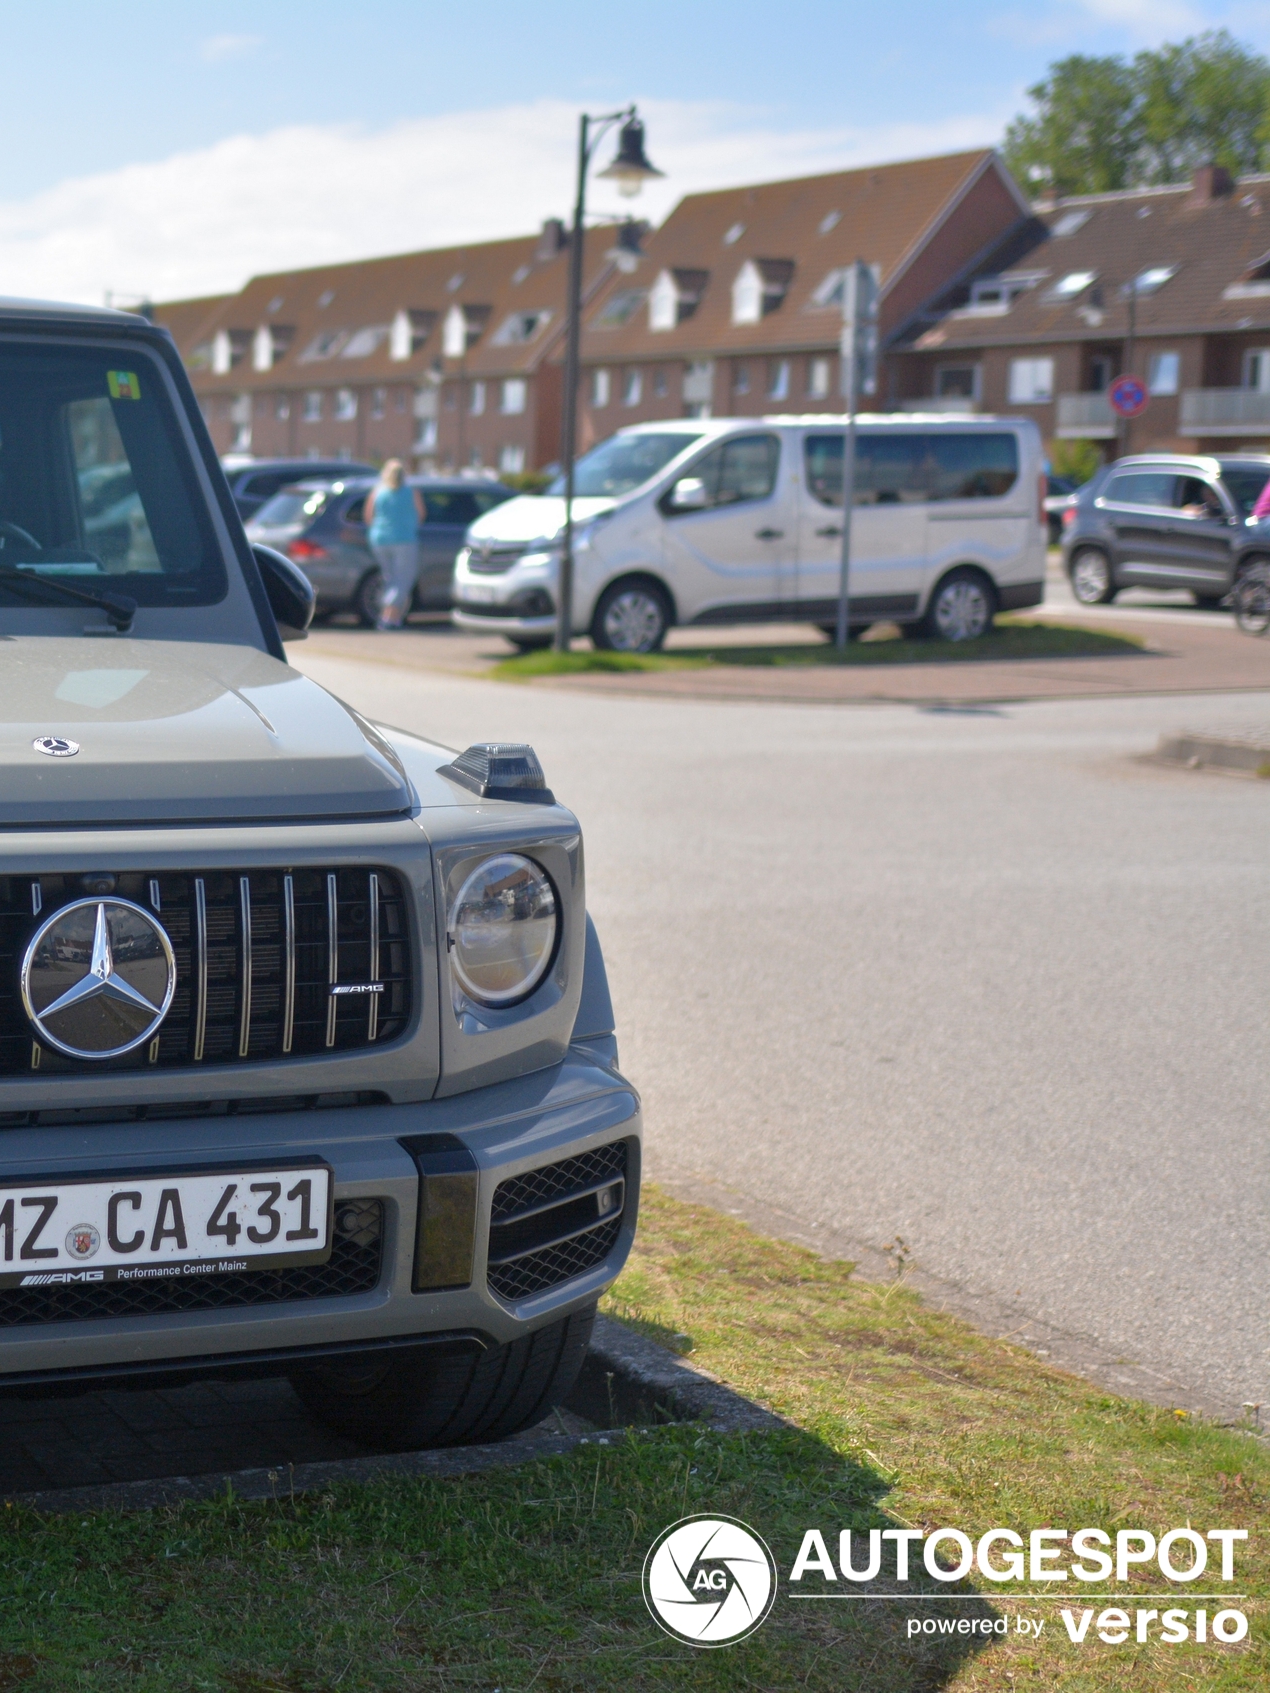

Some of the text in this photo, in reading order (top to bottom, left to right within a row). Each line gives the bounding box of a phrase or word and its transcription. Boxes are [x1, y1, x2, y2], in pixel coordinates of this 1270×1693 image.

[348, 984, 384, 993] AMG
[106, 1188, 188, 1254] CA
[205, 1178, 319, 1246] 431
[47, 1261, 248, 1284] AMG Performance Center Mainz
